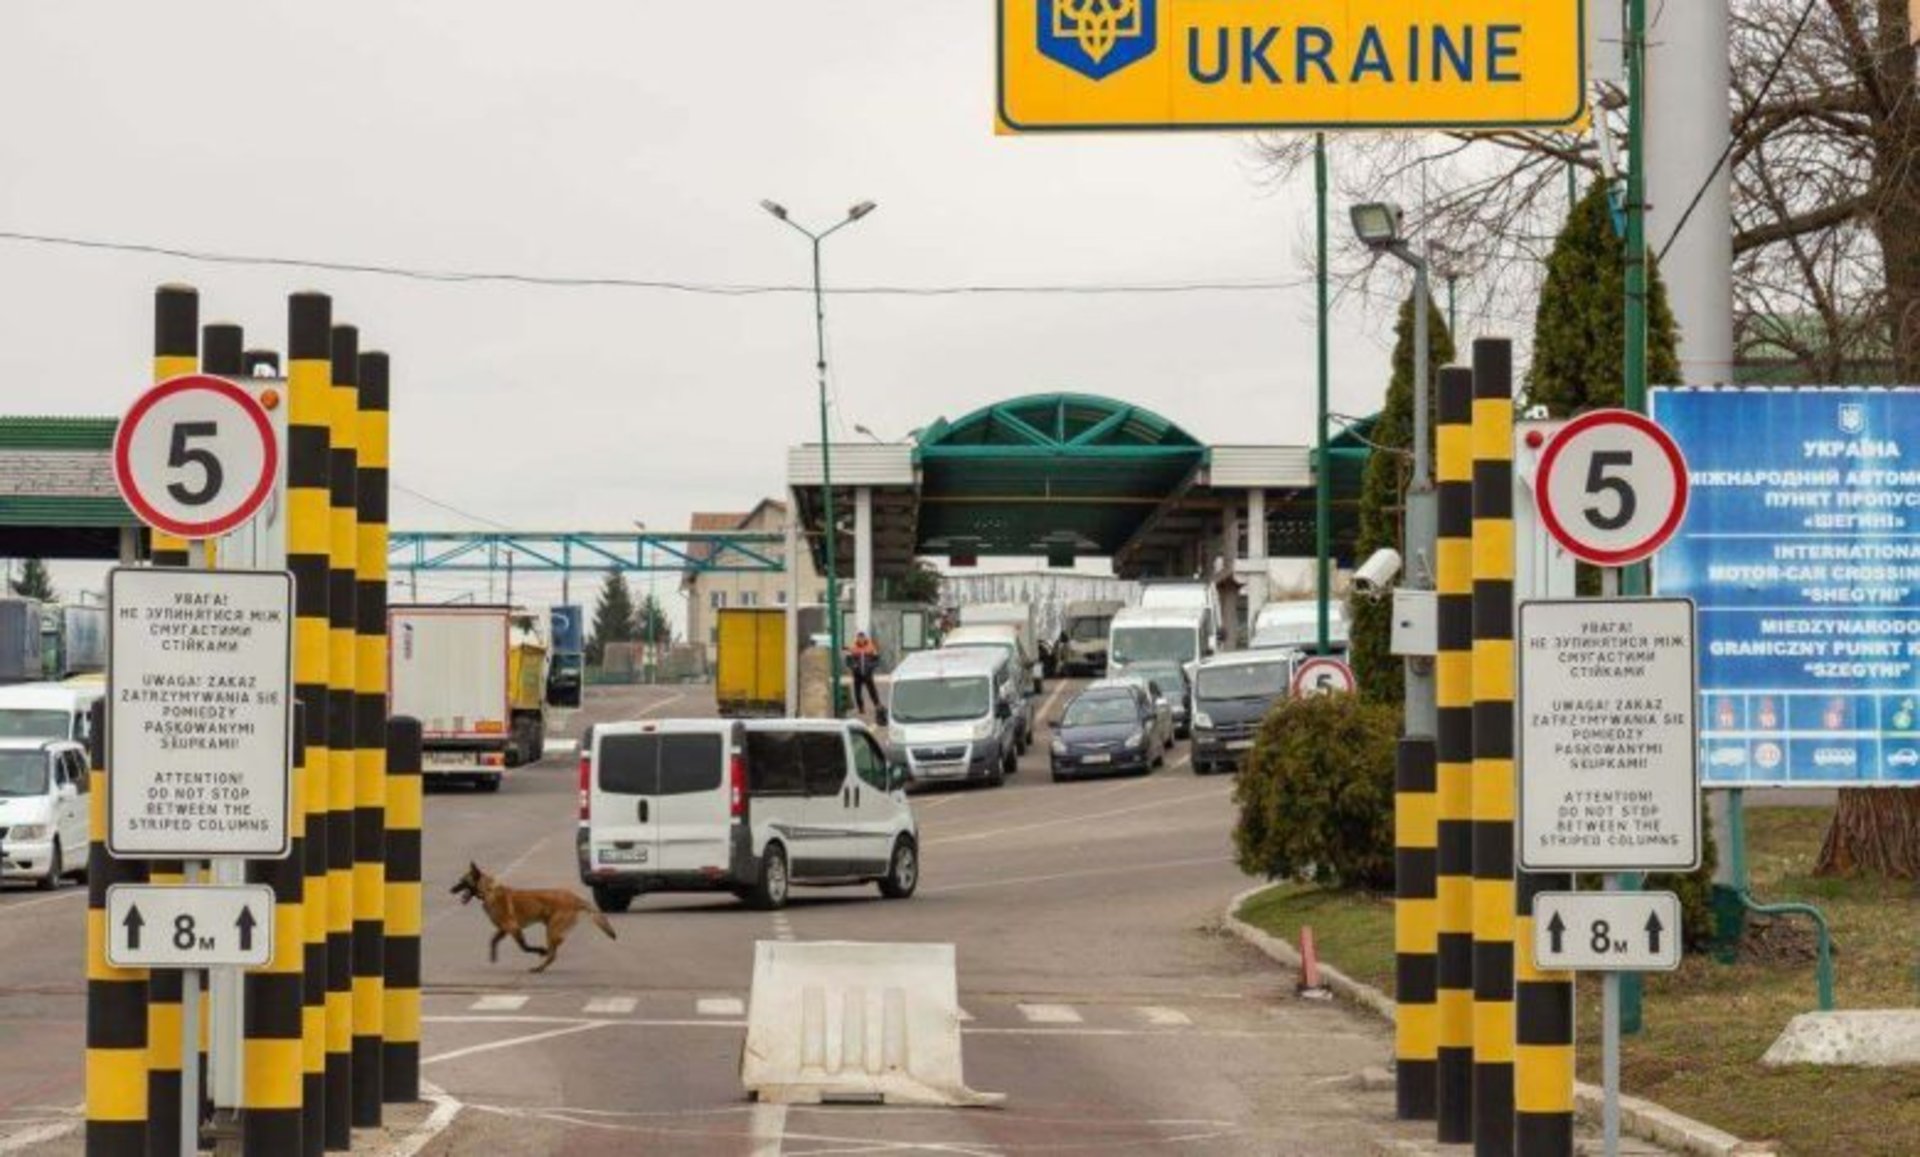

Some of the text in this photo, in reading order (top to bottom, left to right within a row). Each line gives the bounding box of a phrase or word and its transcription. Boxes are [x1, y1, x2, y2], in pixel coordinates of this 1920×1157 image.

[1187, 24, 1522, 84] UKRAINE
[1803, 438, 1900, 458] УКРАЇНА
[167, 421, 223, 506] 5
[1845, 470, 1920, 486] АВТОМ
[1583, 450, 1636, 530] 5
[1765, 491, 1920, 507] ПУНКТ ПРОПУС
[1708, 565, 1825, 581] MOTOR-CAR
[174, 593, 227, 605] УВАГА!
[120, 608, 138, 619] НЕ
[146, 608, 243, 621] ЗУПИНЯТИСЯ
[150, 624, 251, 636] СМУГАСТИМИ
[1581, 622, 1632, 634] УВАГА!
[162, 638, 237, 651] СТІЙКАМИ
[1530, 637, 1546, 649] НЕ
[1654, 636, 1684, 648] МІЖ
[1710, 641, 1826, 655] GRANICZNY
[1833, 641, 1903, 655] PUNKT
[1558, 651, 1655, 663] СМУГАСТИМИ
[1570, 665, 1645, 678] СТІЙКАМИ
[208, 676, 256, 688] ZAKAZ
[121, 689, 249, 702] ZATRZYMYWANIA
[1616, 699, 1662, 710] ZAKAZ
[1532, 714, 1656, 726] ZATRZYMYWANIA
[1555, 743, 1662, 754] PASKOWANYMI
[155, 772, 244, 784] ATTENTION!
[147, 787, 250, 800] DO NOT STOP
[1565, 791, 1652, 803] ATTENTION!
[147, 803, 251, 815] BETWEEN THE
[1558, 805, 1659, 818] DO NOT STOP
[129, 819, 269, 831] STRIPED COLUMNS
[1557, 820, 1660, 832] BETWEEN THE
[1540, 834, 1679, 846] STRIPED COLUMNS
